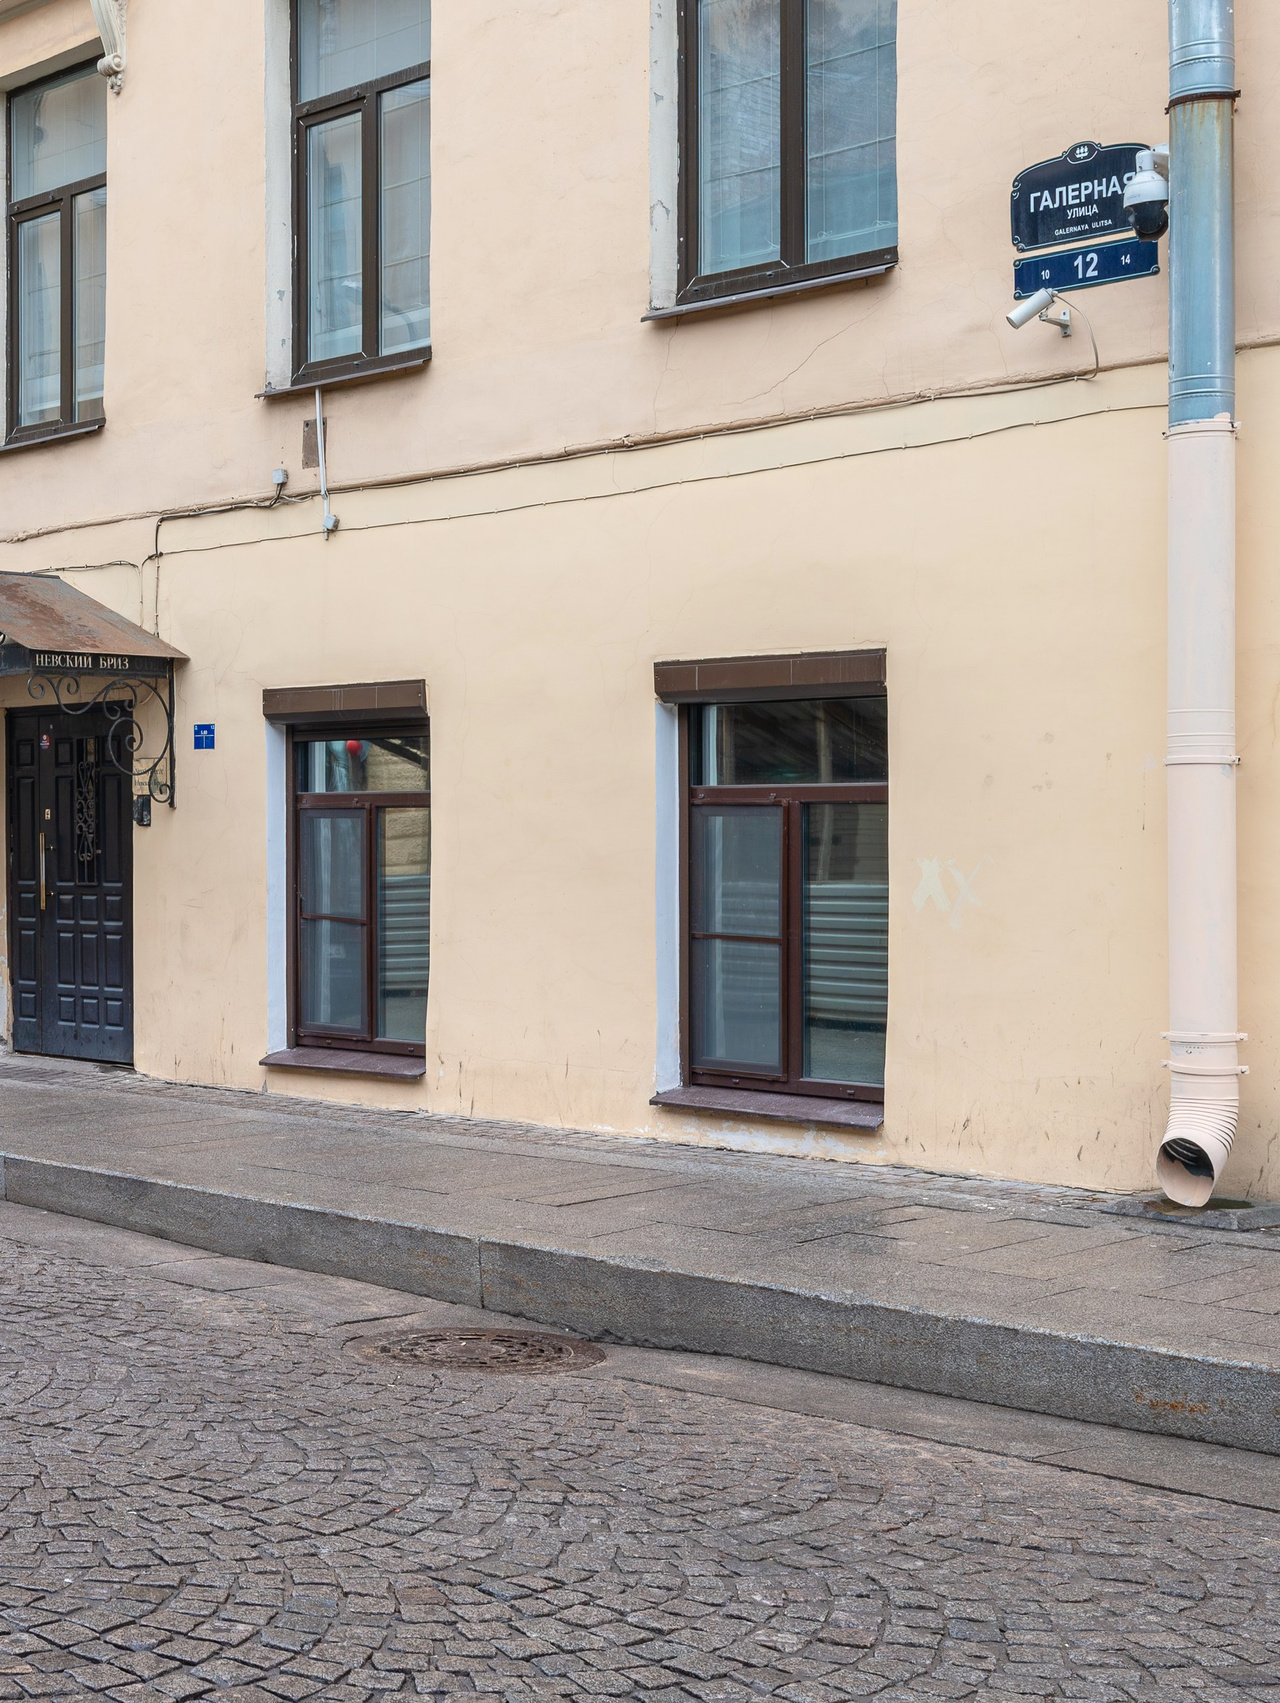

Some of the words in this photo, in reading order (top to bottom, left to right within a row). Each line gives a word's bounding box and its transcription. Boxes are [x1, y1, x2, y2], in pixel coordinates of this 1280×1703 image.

[1066, 203, 1099, 219] УЛИЦА
[1054, 223, 1089, 236] GALERNAYA
[1091, 219, 1112, 229] ULITSA
[1073, 252, 1099, 279] 12
[1120, 254, 1131, 266] 14
[1041, 269, 1050, 280] 10
[35, 653, 93, 669] НЕВСКИЙ
[99, 656, 129, 670] БРИЗ
